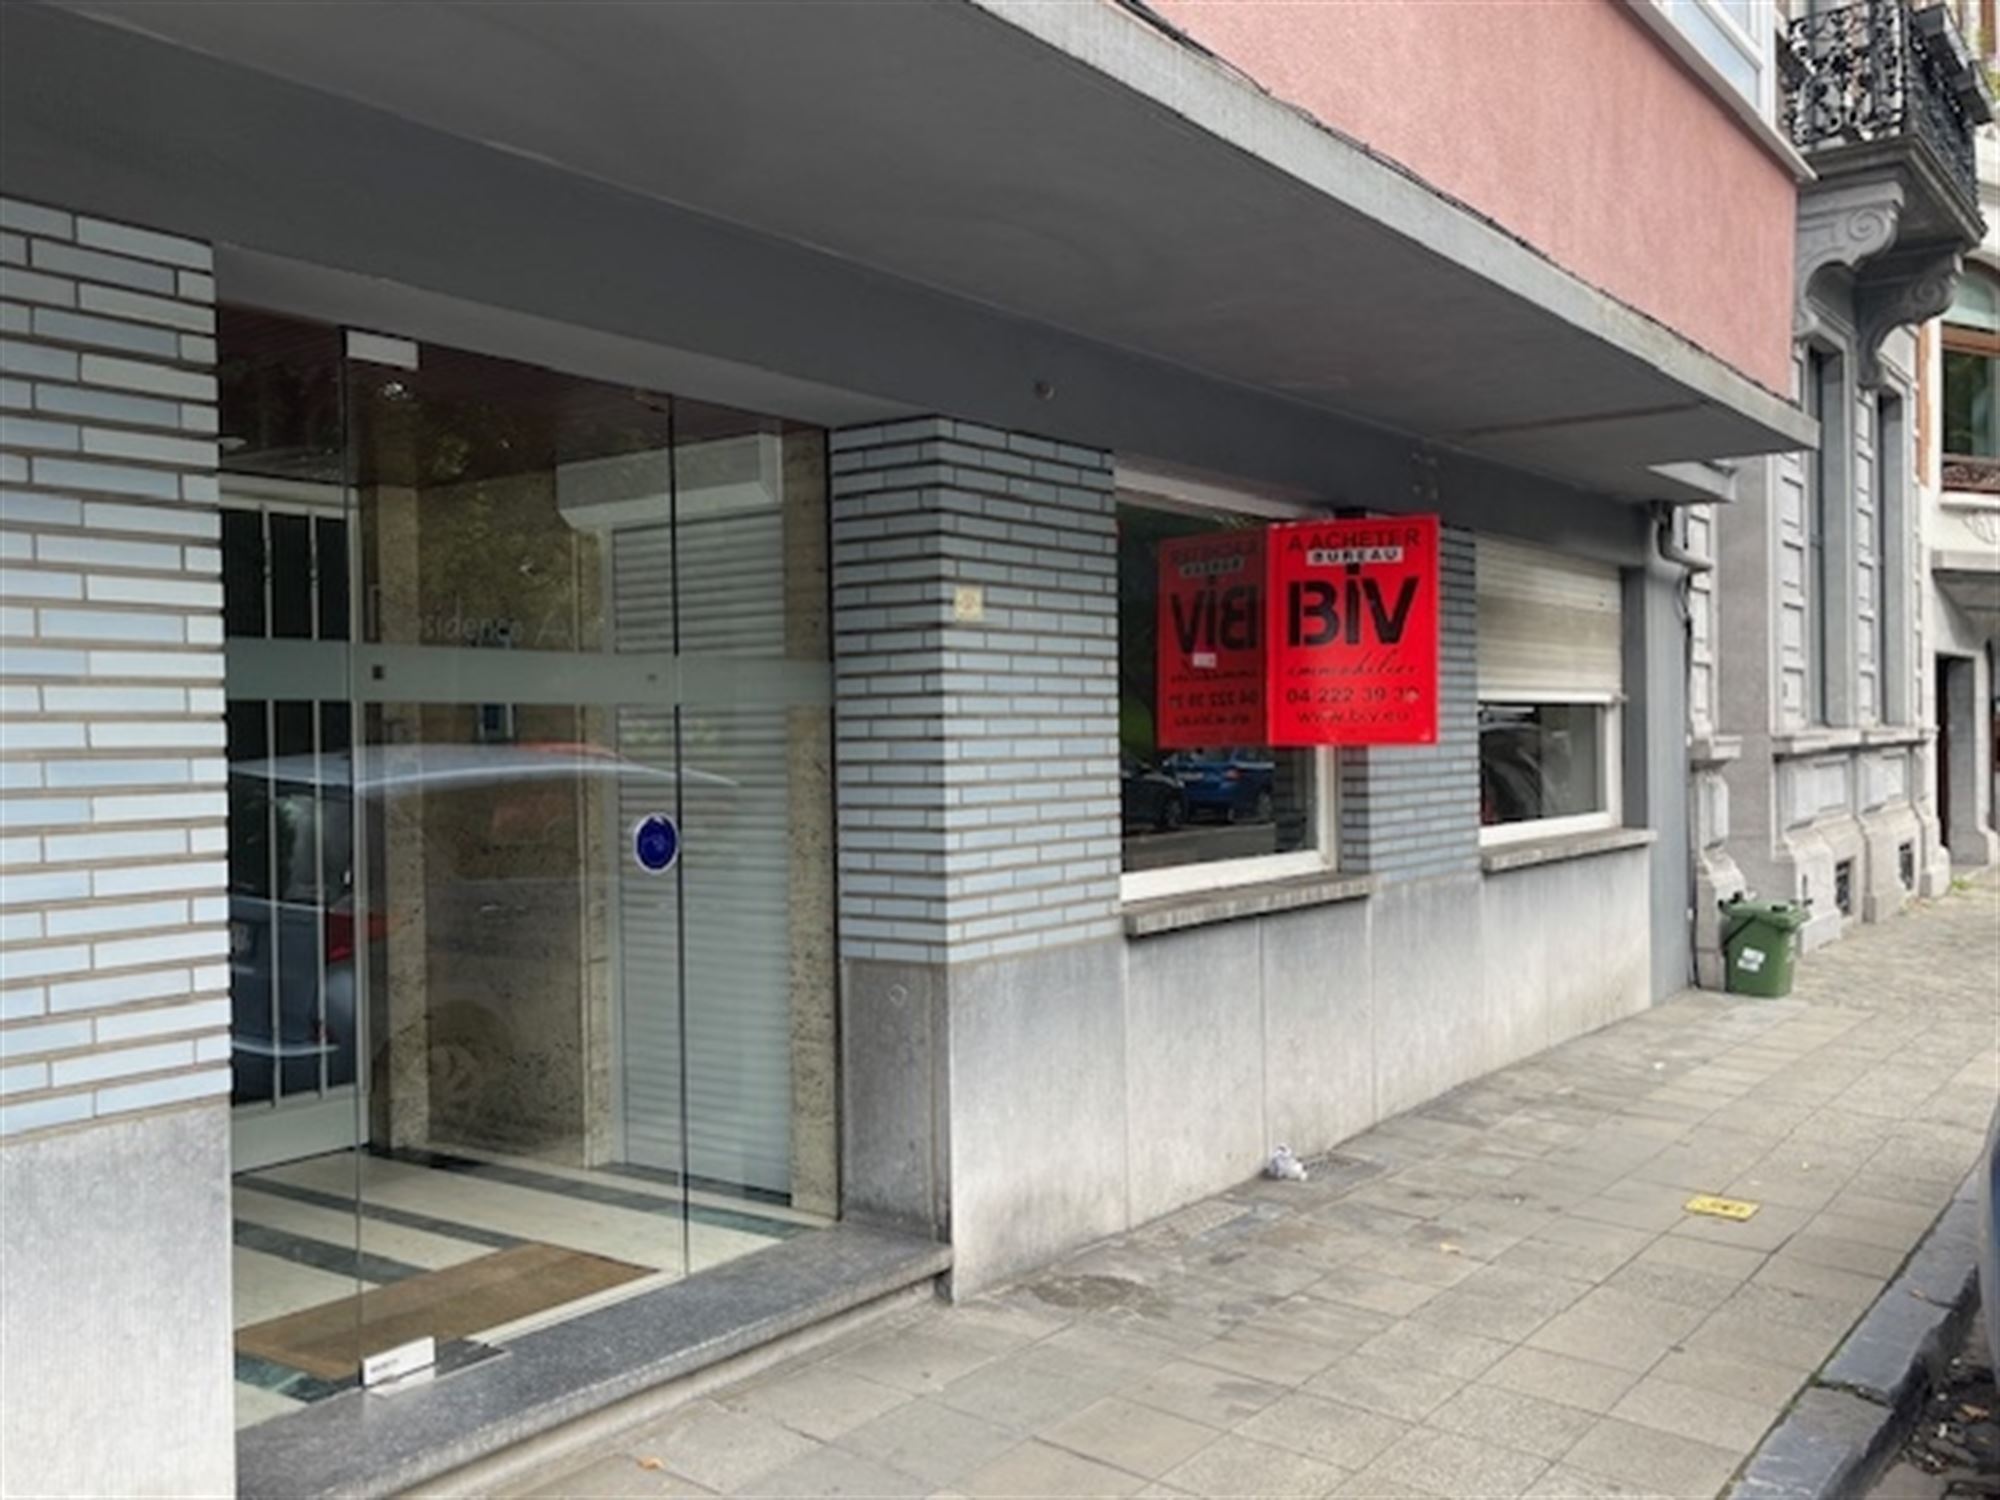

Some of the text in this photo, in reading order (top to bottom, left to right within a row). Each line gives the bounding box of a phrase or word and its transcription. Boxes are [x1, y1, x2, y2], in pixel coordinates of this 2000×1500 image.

[1307, 527, 1420, 550] ACHETER
[1312, 548, 1399, 562] BUREAU
[1286, 687, 1312, 704] 04
[1318, 687, 1355, 703] 222
